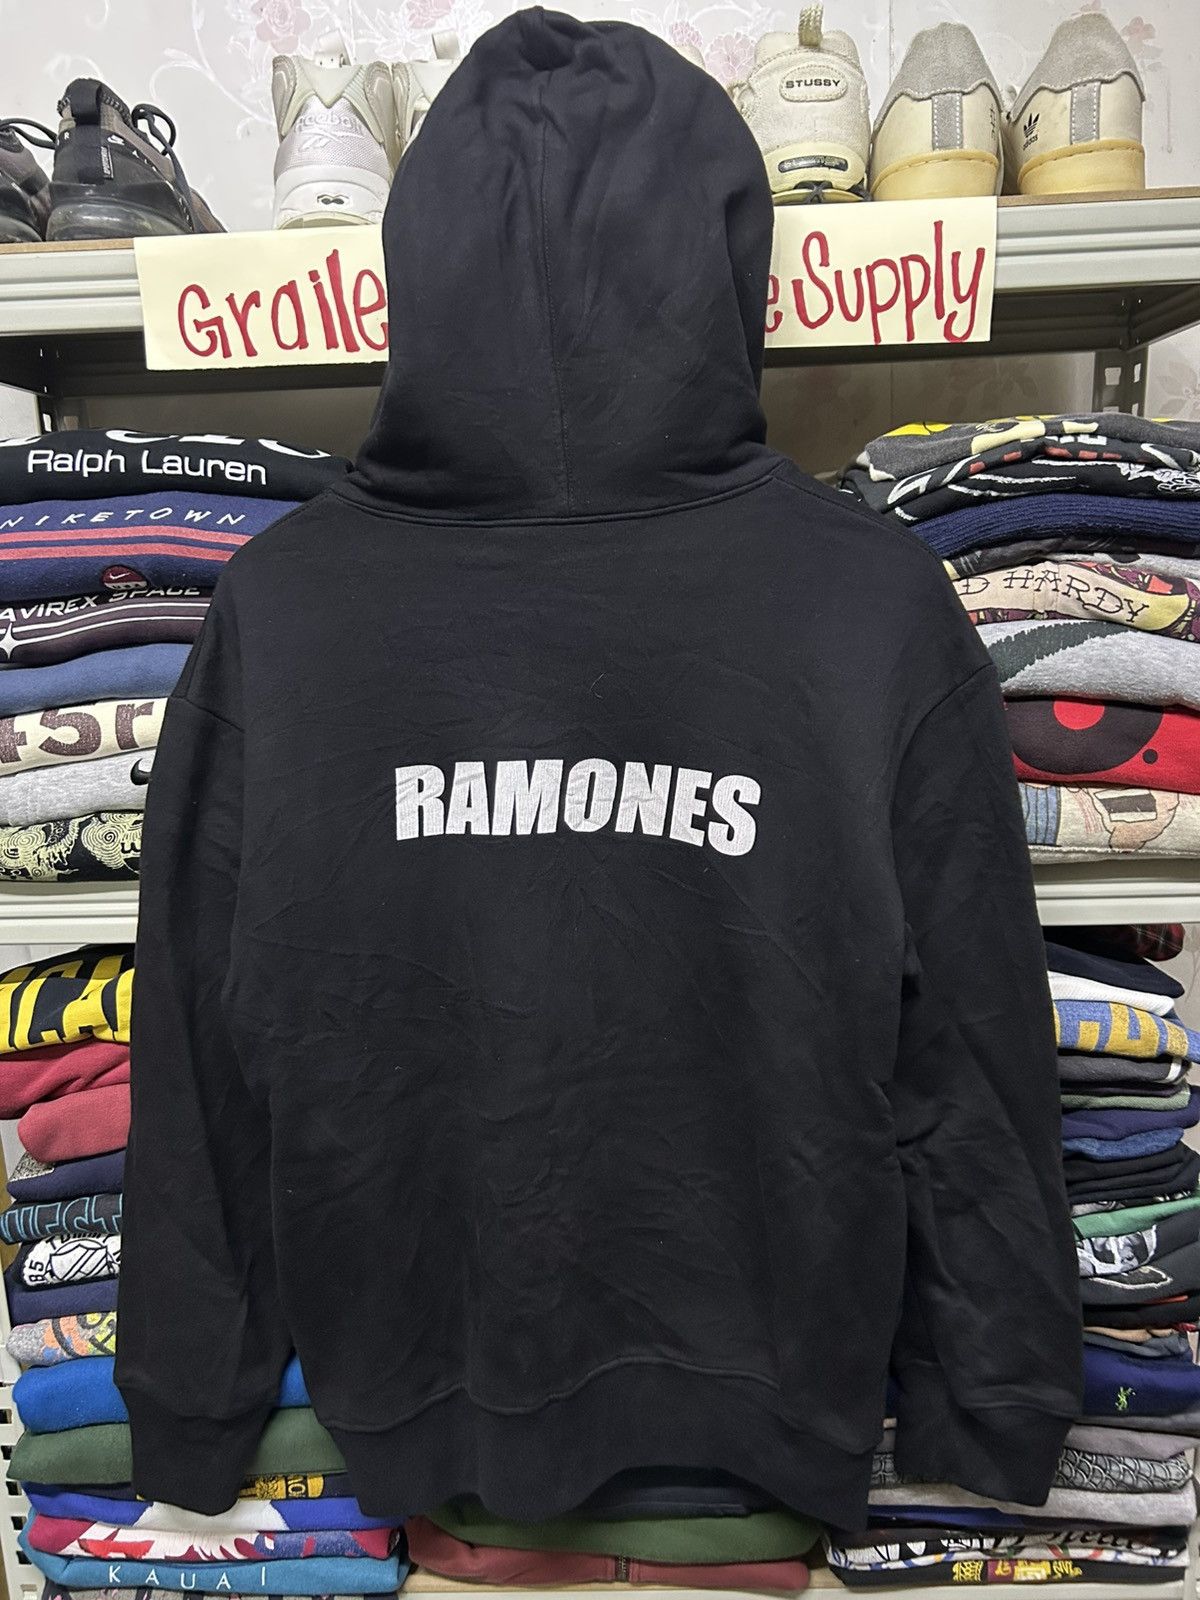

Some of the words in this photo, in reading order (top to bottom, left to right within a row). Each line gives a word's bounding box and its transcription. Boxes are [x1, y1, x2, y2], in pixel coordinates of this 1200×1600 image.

[785, 78, 841, 89] STUSSY
[791, 219, 986, 346] Supply
[27, 449, 126, 478] Ralph
[141, 450, 267, 485] Lauren
[0, 507, 245, 530] NIKETOWN
[0, 595, 100, 622] AVIREX
[1002, 568, 1150, 623] HARDY
[395, 757, 762, 857] RAMONES
[108, 1565, 266, 1590] KAUAI
